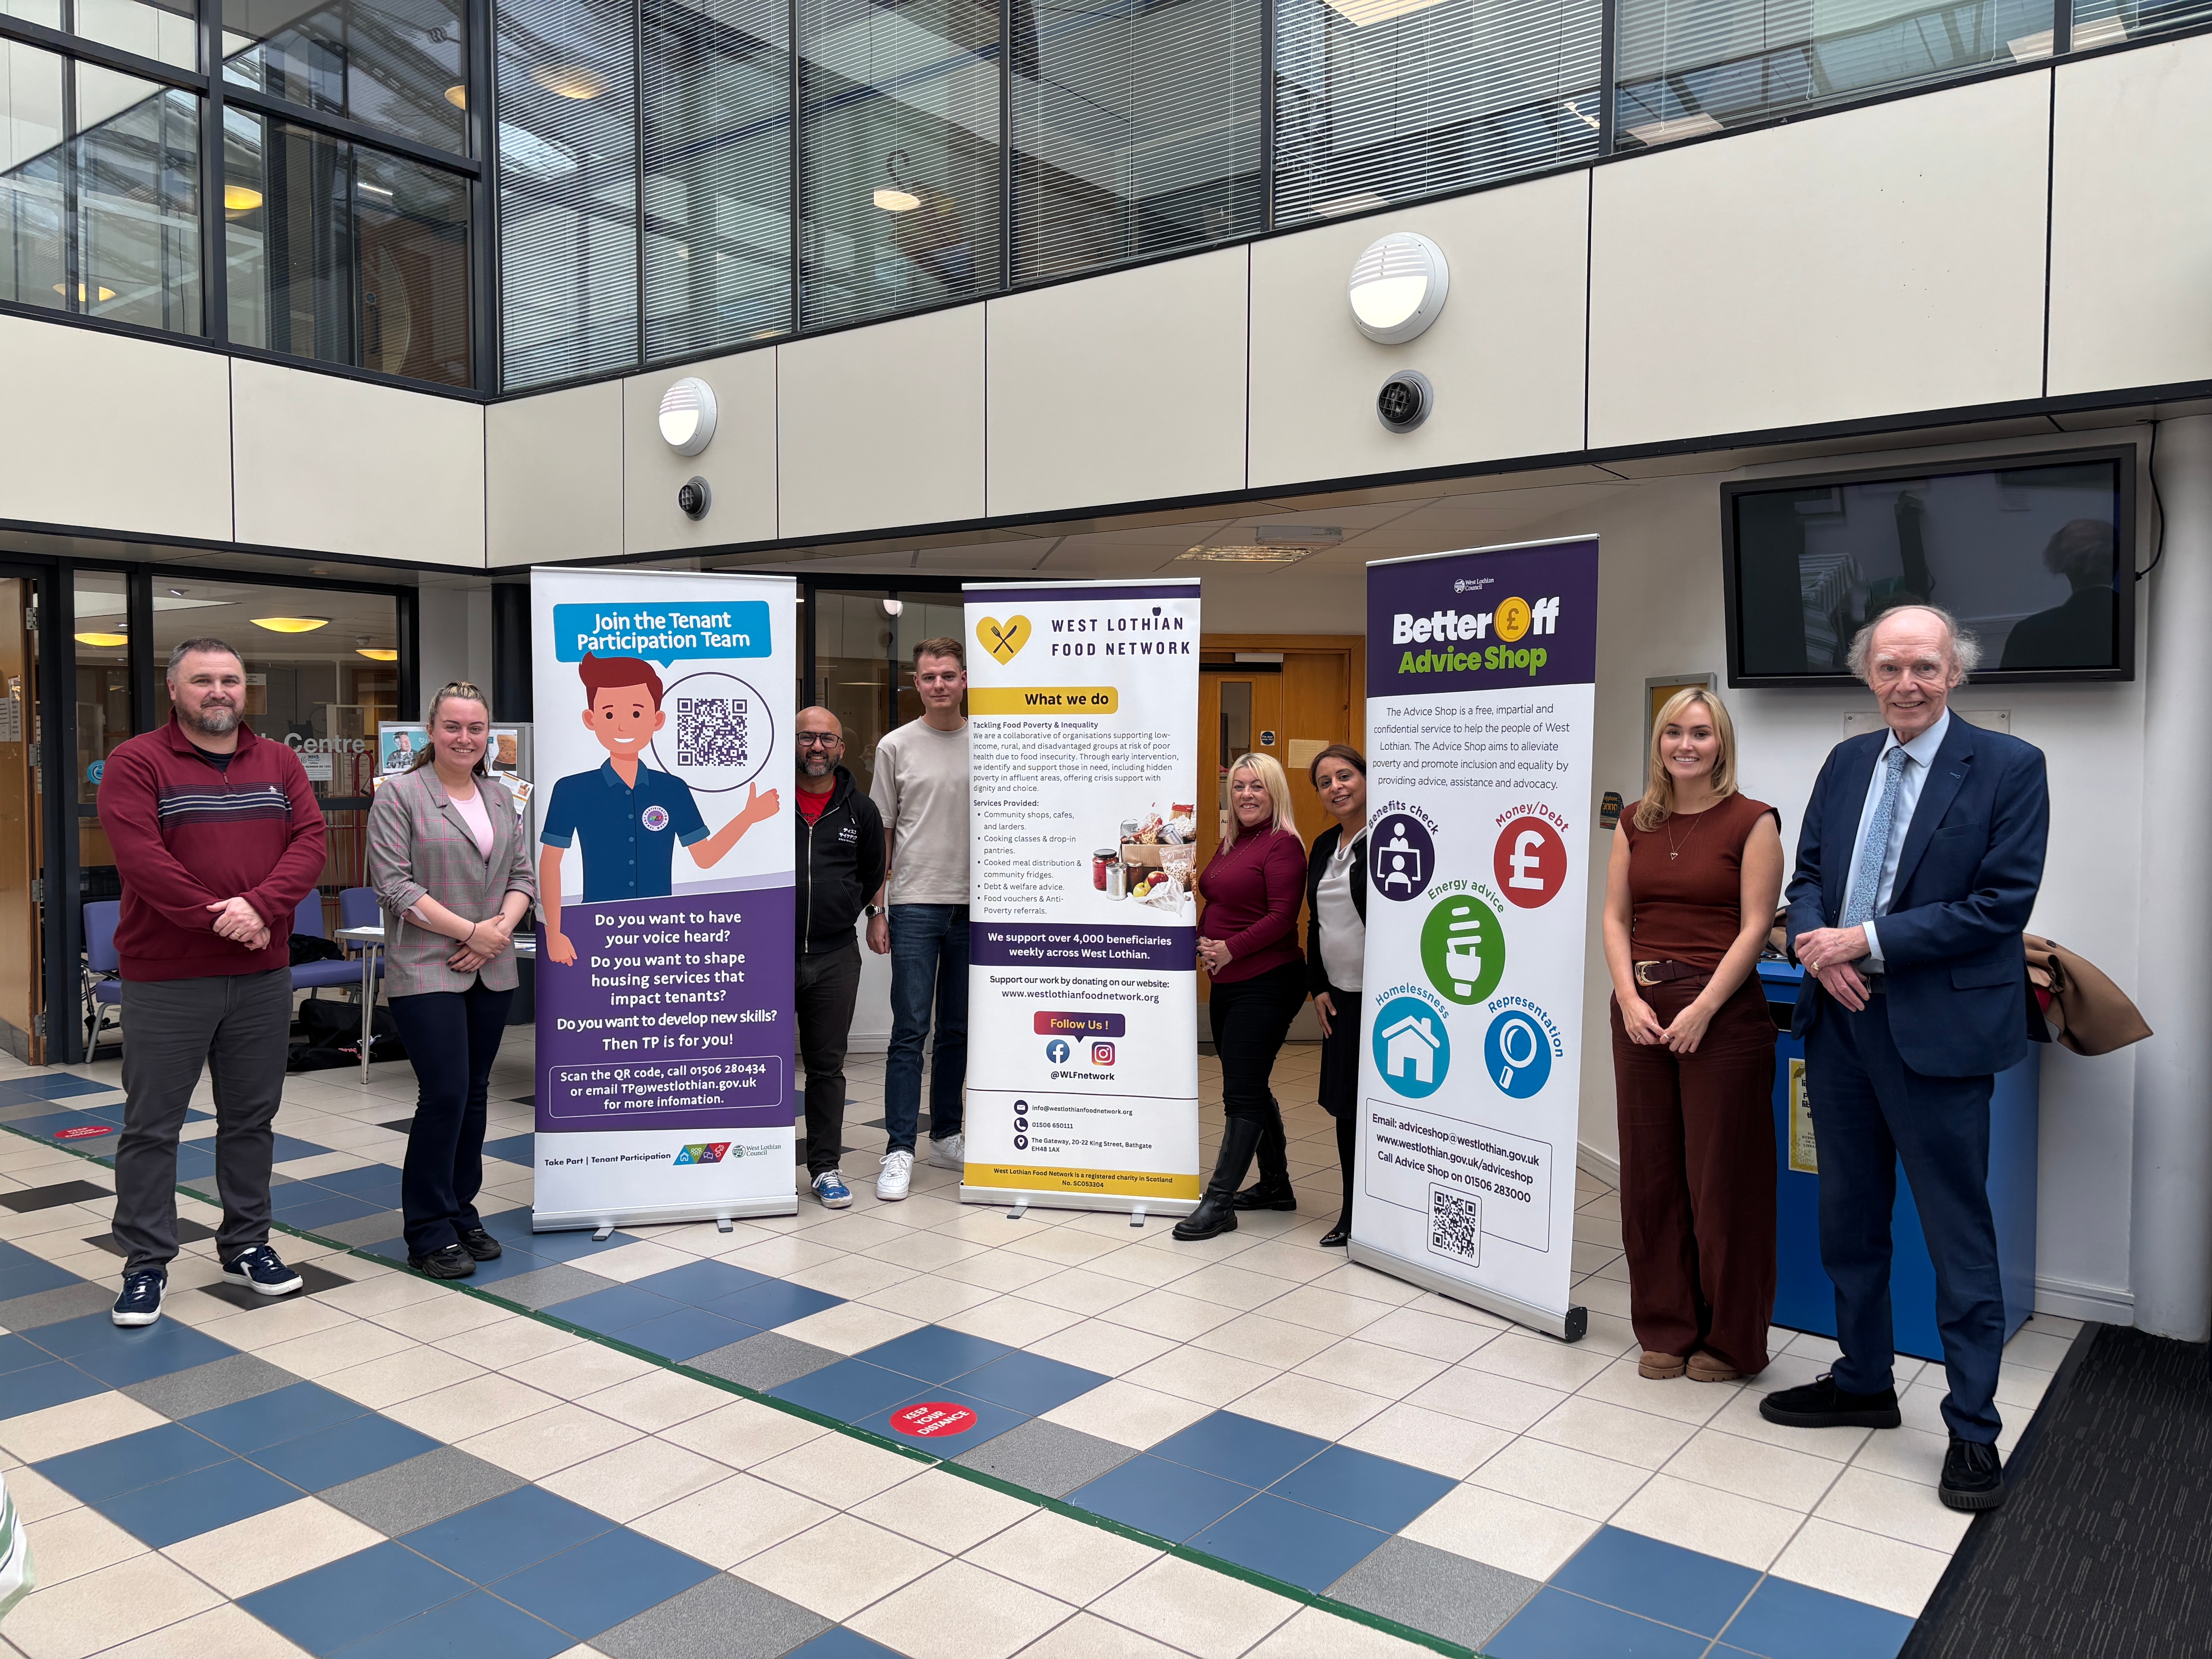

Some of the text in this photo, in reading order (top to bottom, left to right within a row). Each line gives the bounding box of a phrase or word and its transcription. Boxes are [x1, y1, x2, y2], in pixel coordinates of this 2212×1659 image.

[592, 611, 732, 634] Join the Tenant
[1051, 617, 1183, 632] WEST LOTHIAN
[1393, 610, 1492, 644] Better
[577, 630, 750, 653] Participation Team
[1052, 641, 1190, 656] FOOD NETWORK
[1398, 645, 1547, 676] Advice Shop
[1025, 692, 1109, 705] What we do
[973, 721, 1001, 730] Tackling
[1023, 721, 1052, 730] Poverty
[1061, 721, 1099, 730] Inequality
[284, 733, 366, 753] Centre
[1378, 776, 1558, 791] providing advice, assistance and advocacy.
[984, 811, 1074, 820] Community shops, cafes,
[1368, 800, 1439, 836] Benefits check
[1495, 801, 1569, 833] Money/Debt
[984, 835, 1013, 843] Cooking
[1049, 835, 1076, 844] drop-in
[984, 847, 1015, 855] pantries.
[1427, 878, 1504, 914] Energy advice
[988, 933, 1003, 941] We
[1006, 934, 1046, 944] support
[1073, 934, 1104, 945] 4,000
[1107, 934, 1172, 946] beneficiaries
[591, 952, 745, 970] Do you want to shape
[1009, 947, 1044, 958] weekly
[1081, 948, 1107, 958] West
[1109, 949, 1150, 959] Lothian.
[592, 970, 745, 988] housing services that
[611, 989, 726, 1008] impact tenants?
[1001, 990, 1159, 1004] www.westlothianfoodnetwork.org
[1375, 982, 1450, 1019] Homelessness
[1051, 1018, 1108, 1030] Follow Us !
[1488, 996, 1563, 1058] Representation
[602, 1033, 733, 1051] Then TP is for you!
[560, 1063, 766, 1082] Scan the QR code, call 01506 280434
[1051, 1071, 1115, 1080] @WLFnetwork
[570, 1077, 756, 1096] or email TP@westlothian.gov.uk
[603, 1094, 724, 1109] for more infomation.
[1032, 1105, 1133, 1116] info@westlothianfoodnetwork.org
[1372, 1113, 1539, 1166] Email: adviceshop@westlothian.gov.uk
[620, 1152, 671, 1162] Participation
[1376, 1133, 1533, 1185] www.westlothian.gov.uk/adviceshop
[1378, 1151, 1531, 1203] Call Advice Shop on 01506 283000
[902, 1407, 929, 1420] KEEP
[913, 1411, 947, 1425] YOUR
[917, 1410, 970, 1435] DISTANCE
